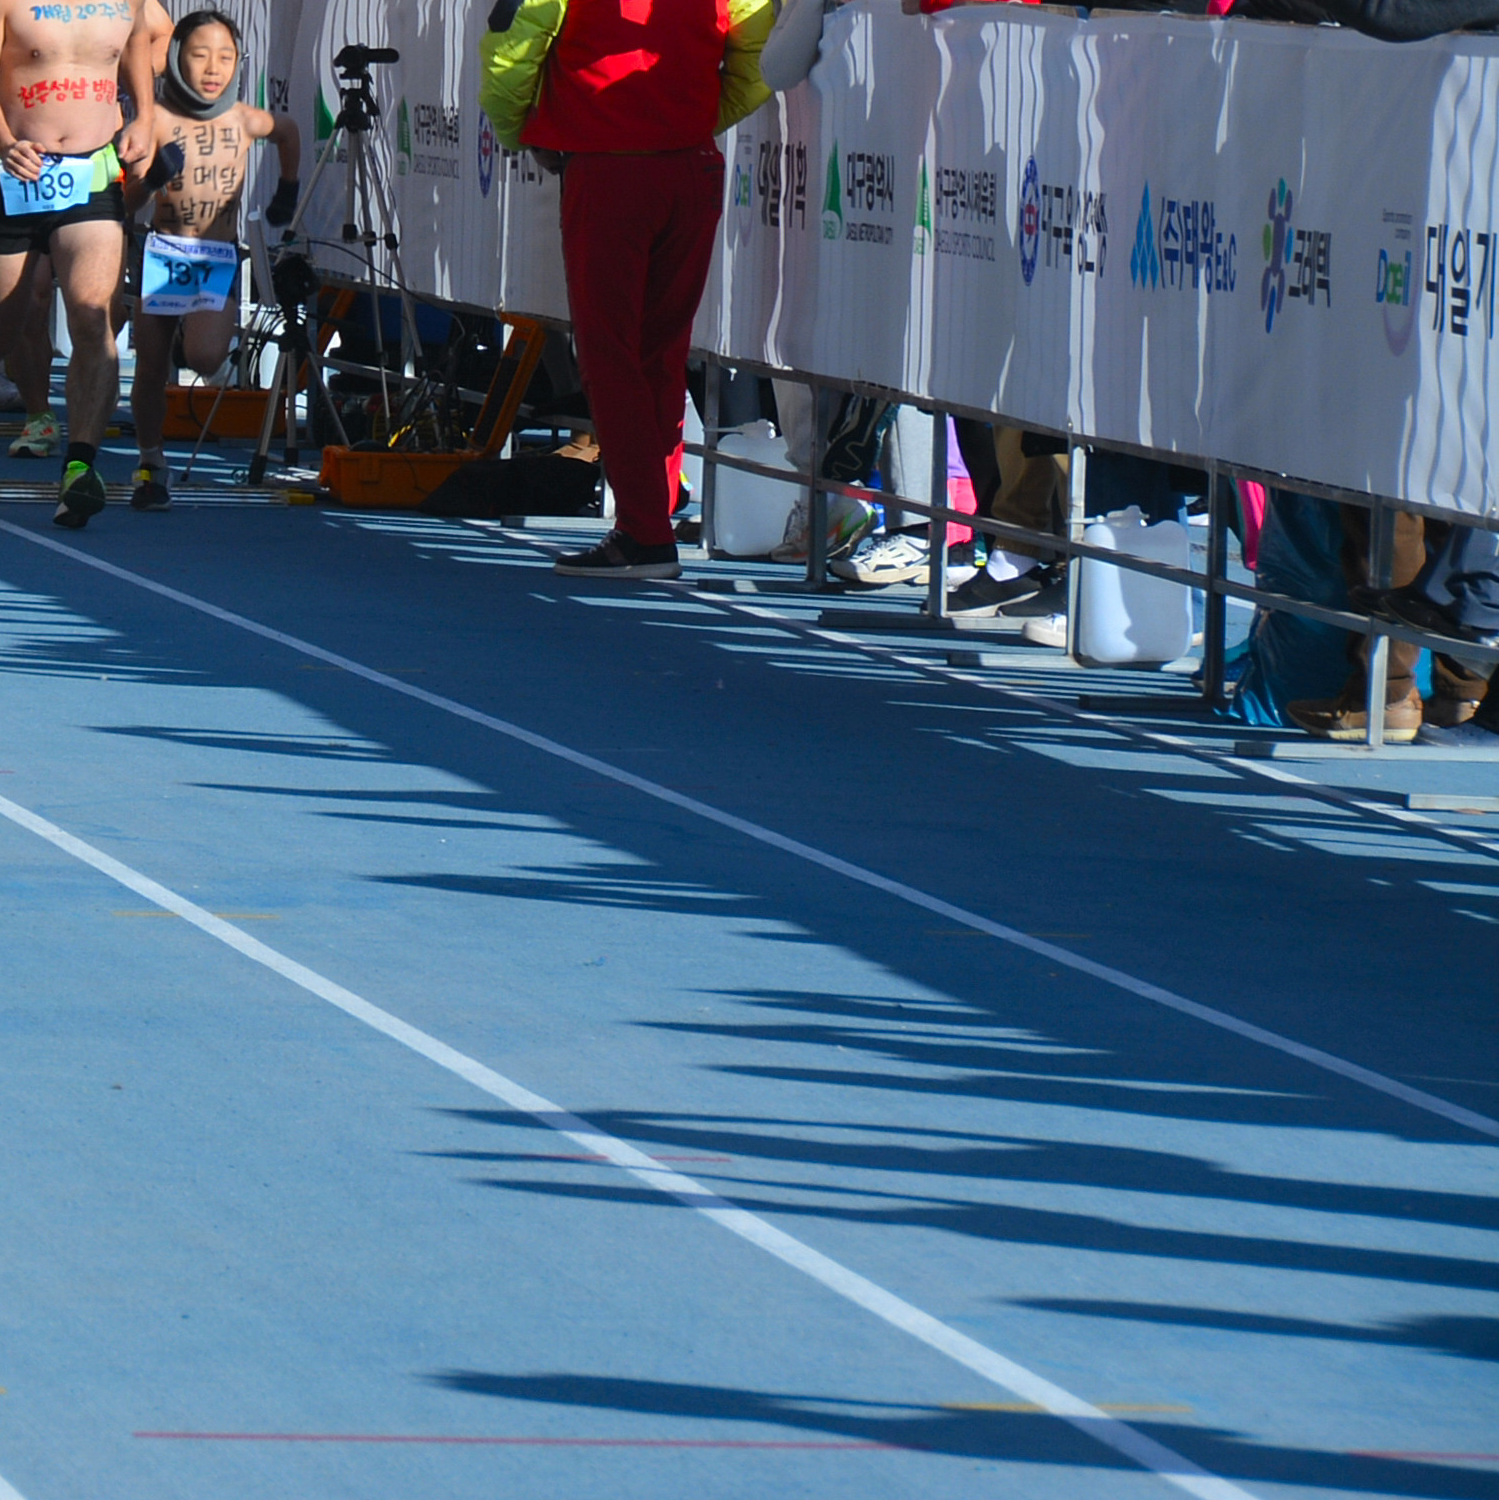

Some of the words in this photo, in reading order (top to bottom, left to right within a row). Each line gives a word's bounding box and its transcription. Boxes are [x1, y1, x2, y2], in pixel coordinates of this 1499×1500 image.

[17, 171, 76, 204] 1139
[846, 151, 895, 212] 대구광역시
[1288, 229, 1332, 309] 크레텍
[1425, 223, 1499, 341] 대일기
